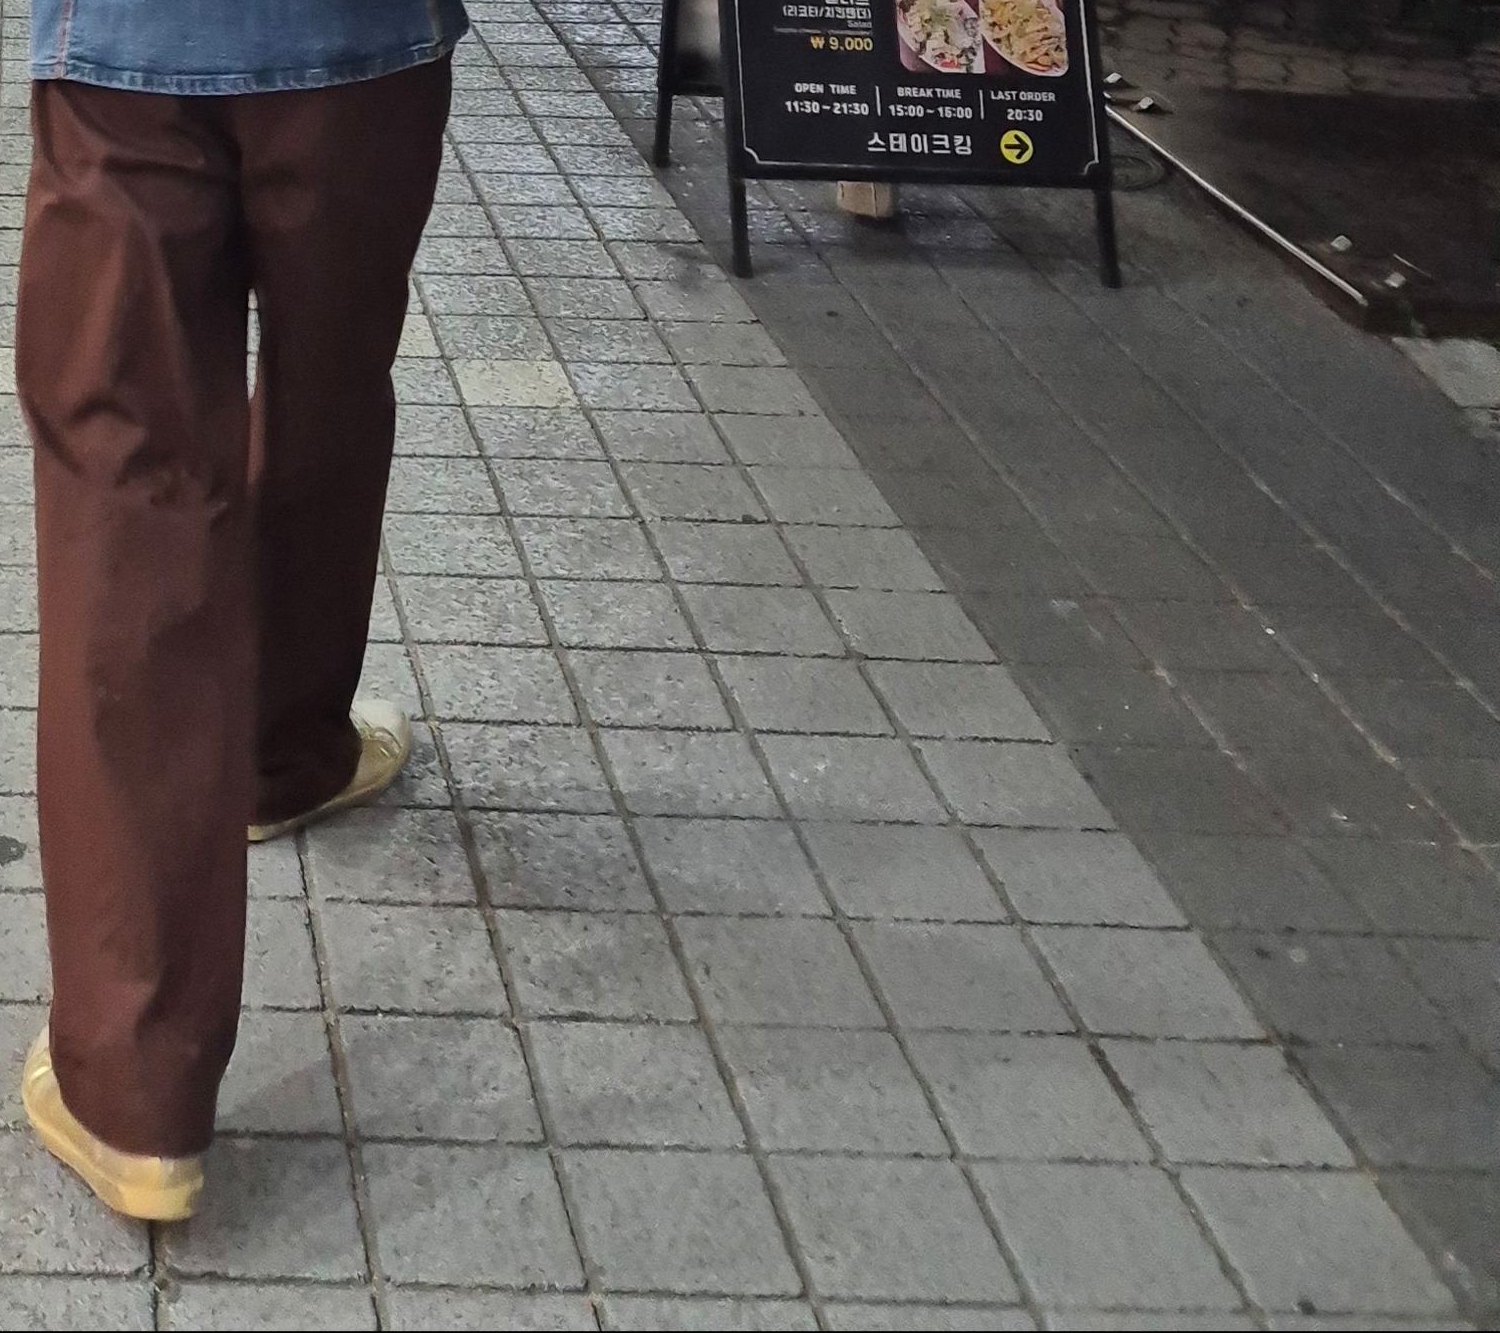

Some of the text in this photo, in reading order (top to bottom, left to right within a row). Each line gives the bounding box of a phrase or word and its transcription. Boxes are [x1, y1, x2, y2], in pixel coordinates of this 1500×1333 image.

[794, 83, 857, 95] OPEN TIME
[897, 86, 961, 99] BREAK TIME
[990, 90, 1056, 102] LAST ORDER
[1006, 108, 1043, 121] 20:30
[867, 132, 972, 155] 스테이크킹
